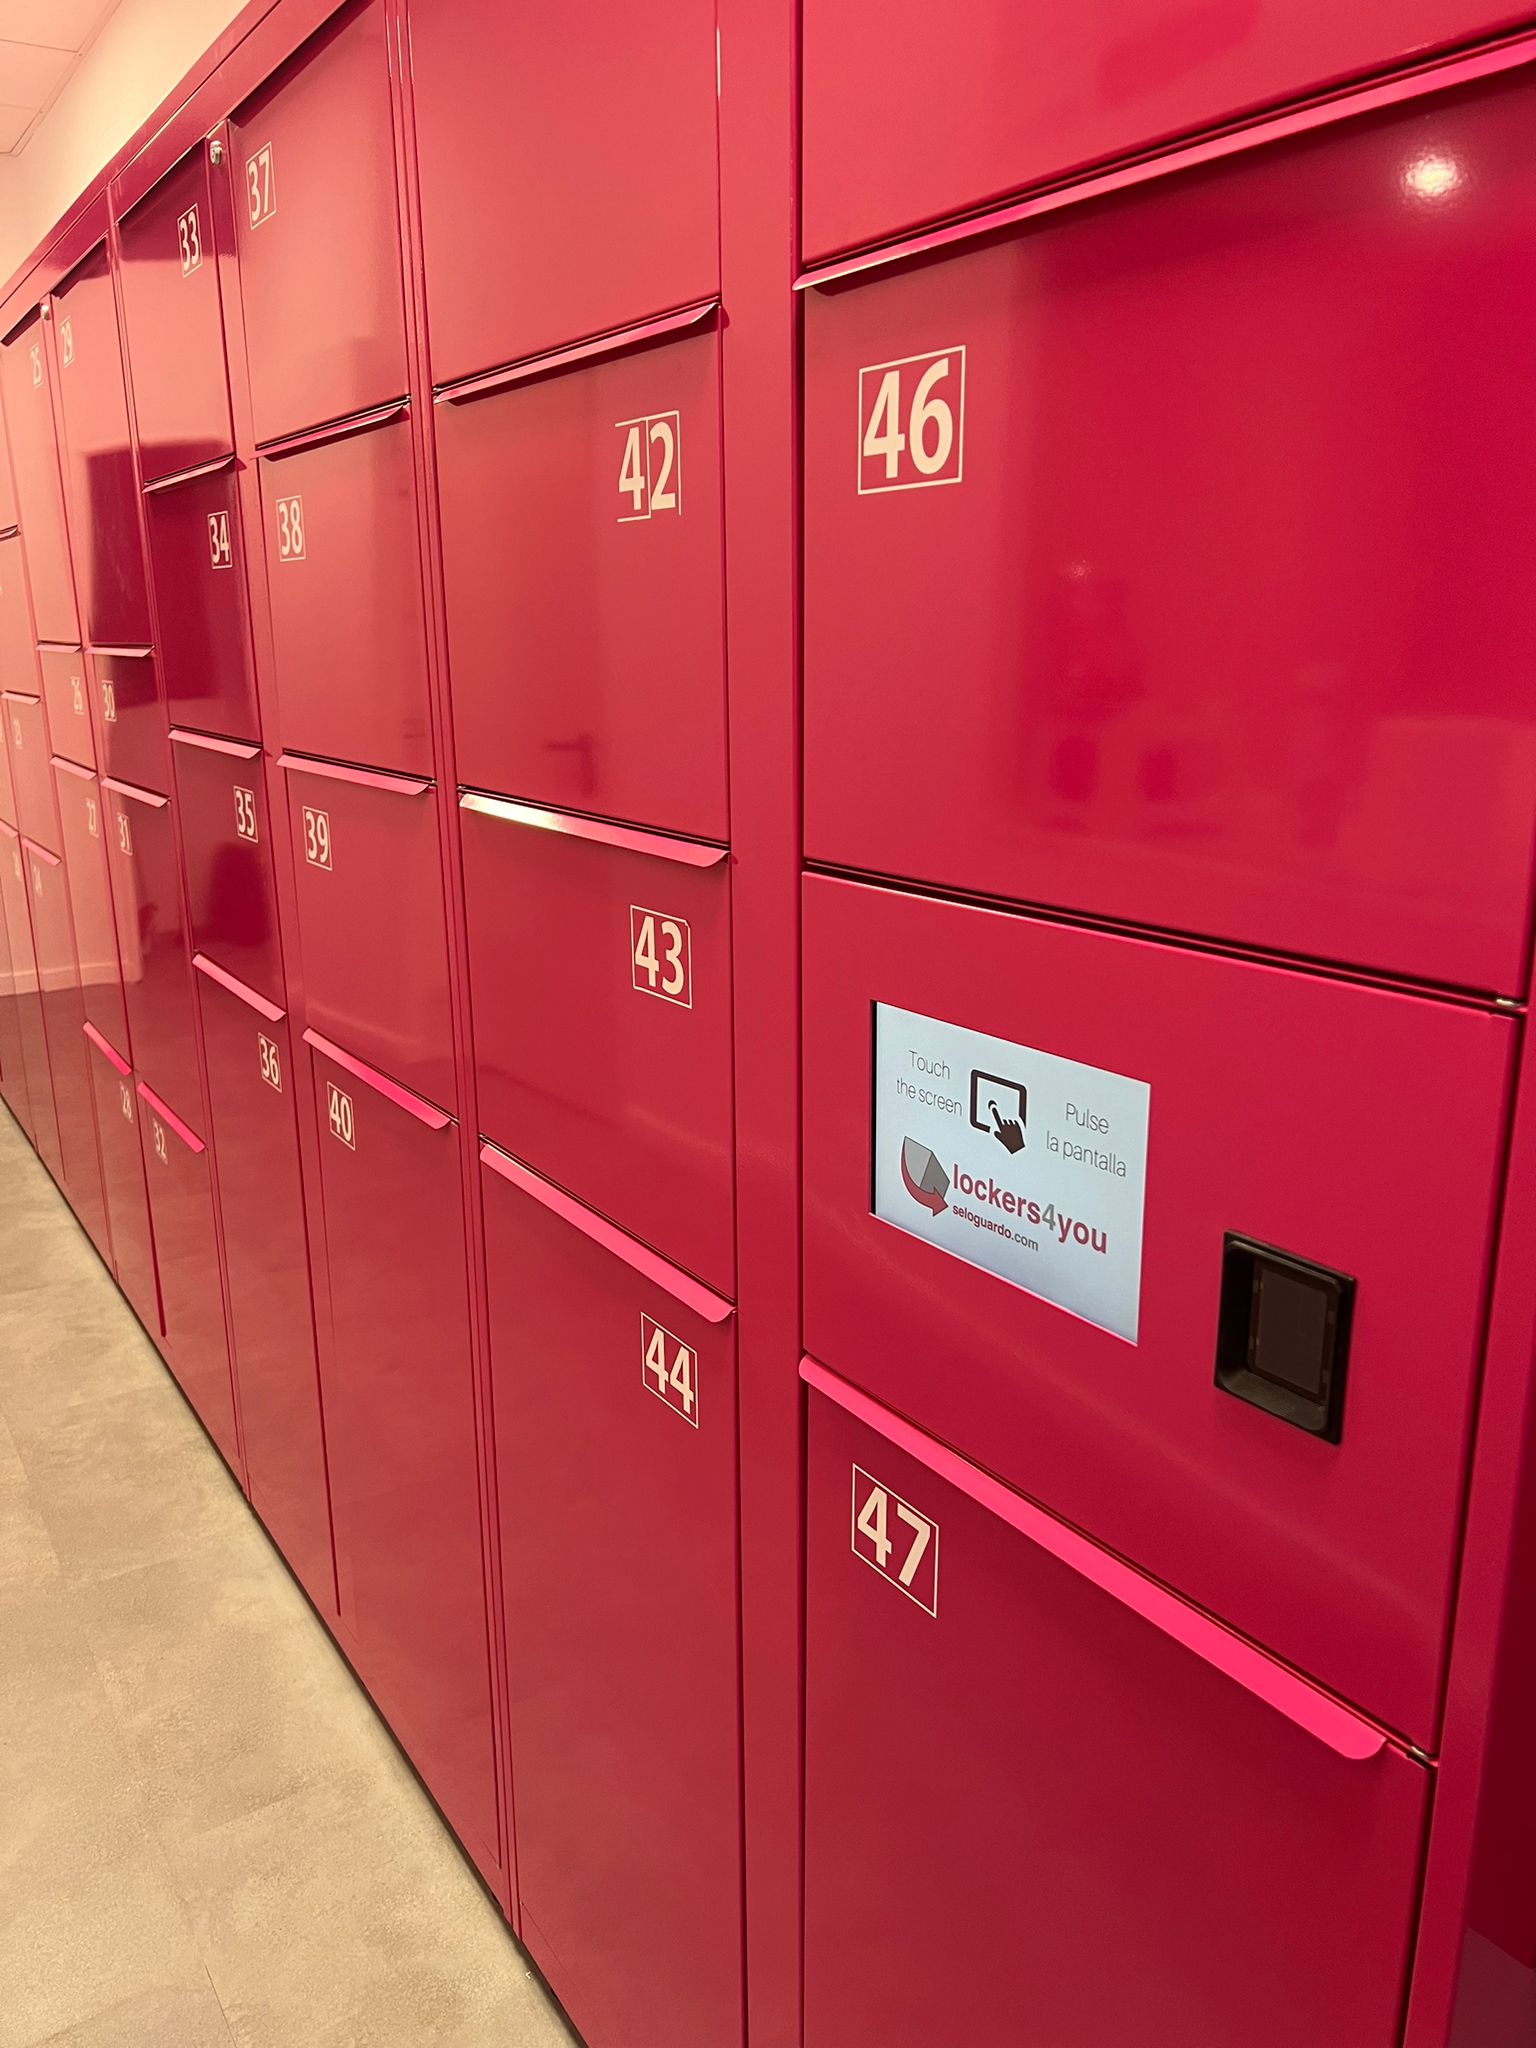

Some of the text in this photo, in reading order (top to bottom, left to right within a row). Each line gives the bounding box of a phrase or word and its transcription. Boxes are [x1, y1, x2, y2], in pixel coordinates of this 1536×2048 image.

[248, 149, 271, 222] 37
[178, 210, 201, 272] 33
[862, 356, 954, 479] 46
[618, 420, 677, 511] 42
[209, 514, 230, 564] 34
[279, 499, 303, 556] 38
[102, 683, 115, 718] 30
[118, 814, 130, 851] 31
[235, 789, 256, 838] 35
[305, 808, 329, 864] 39
[634, 915, 685, 996] 43
[259, 1037, 280, 1086] 36
[908, 1050, 951, 1081] Touch
[328, 1089, 353, 1143] 40
[896, 1078, 963, 1117] the screen
[1065, 1102, 1110, 1135] Pulse
[153, 1120, 167, 1159] 32
[1046, 1130, 1127, 1178] la pantalla
[952, 1162, 1108, 1255] lockers4you
[952, 1203, 1040, 1252] seloguardo.com
[645, 1326, 695, 1415] 44
[857, 1485, 931, 1588] 47
